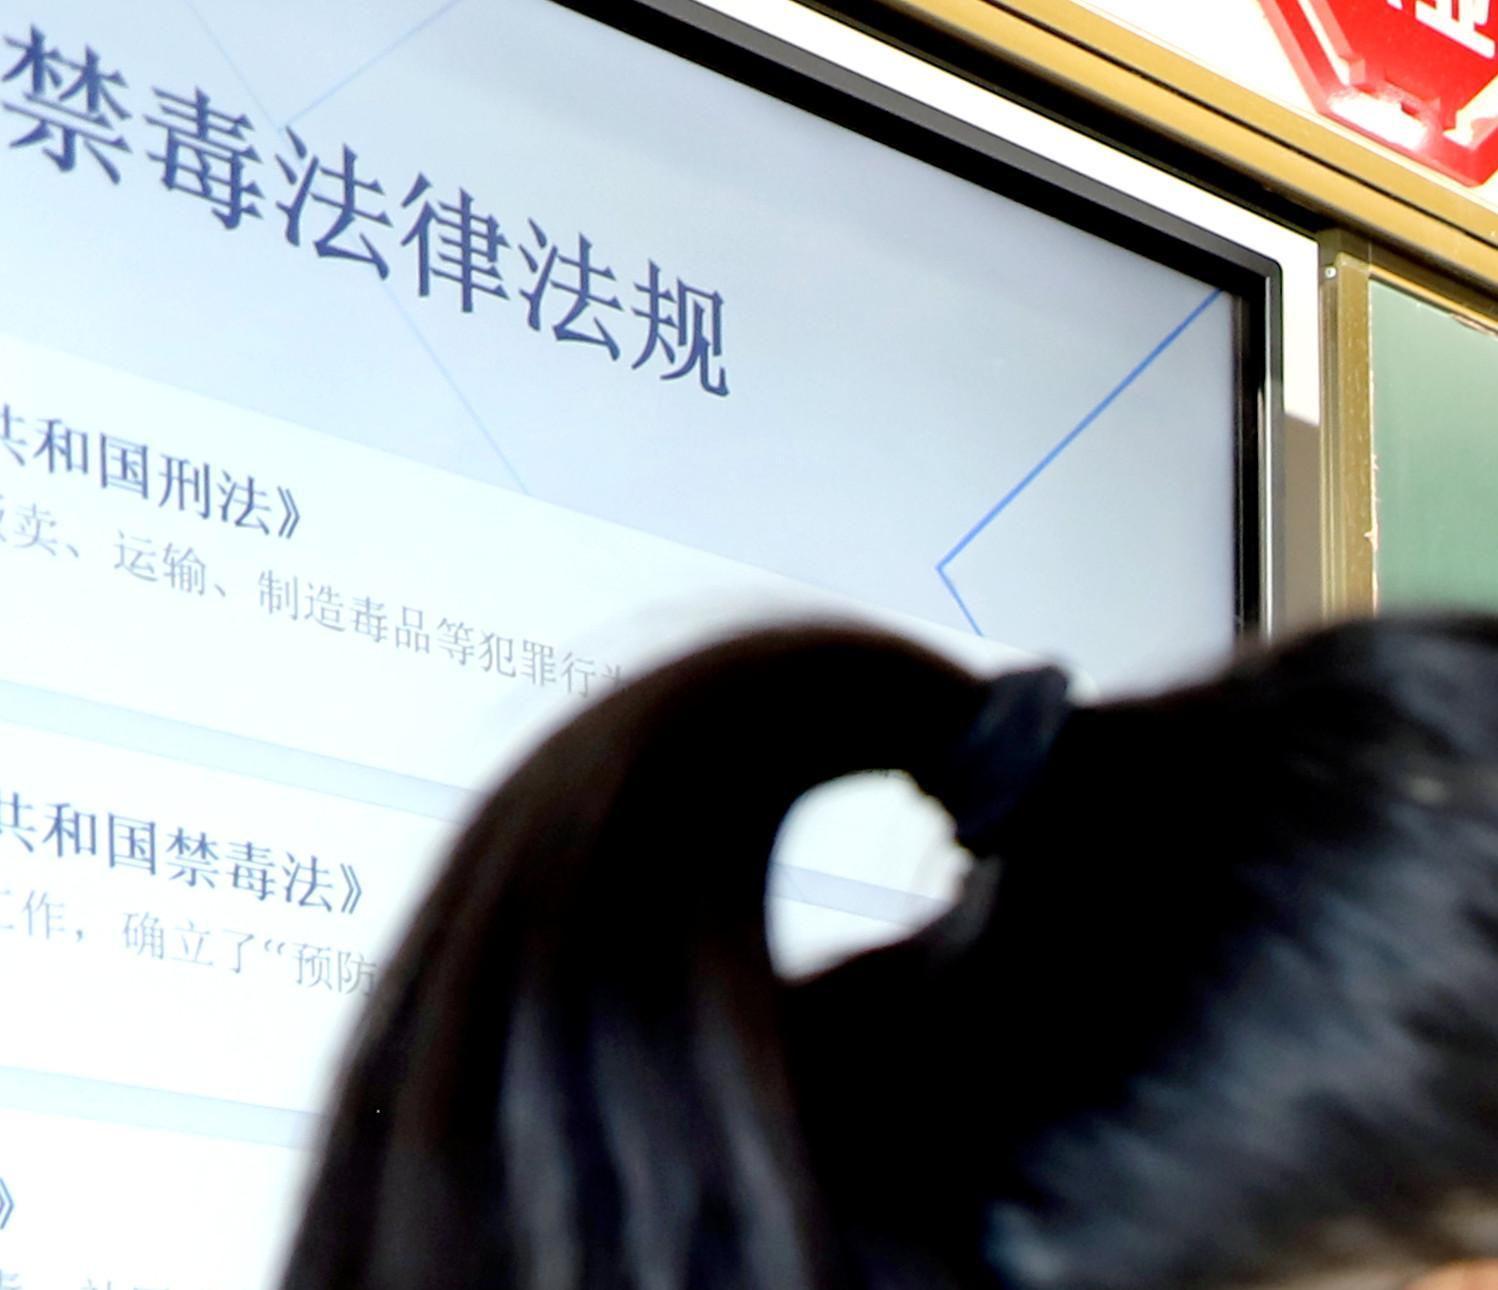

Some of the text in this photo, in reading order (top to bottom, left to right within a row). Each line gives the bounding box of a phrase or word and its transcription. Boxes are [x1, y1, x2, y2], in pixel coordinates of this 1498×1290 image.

[2, 25, 730, 398] 禁毒法律法规
